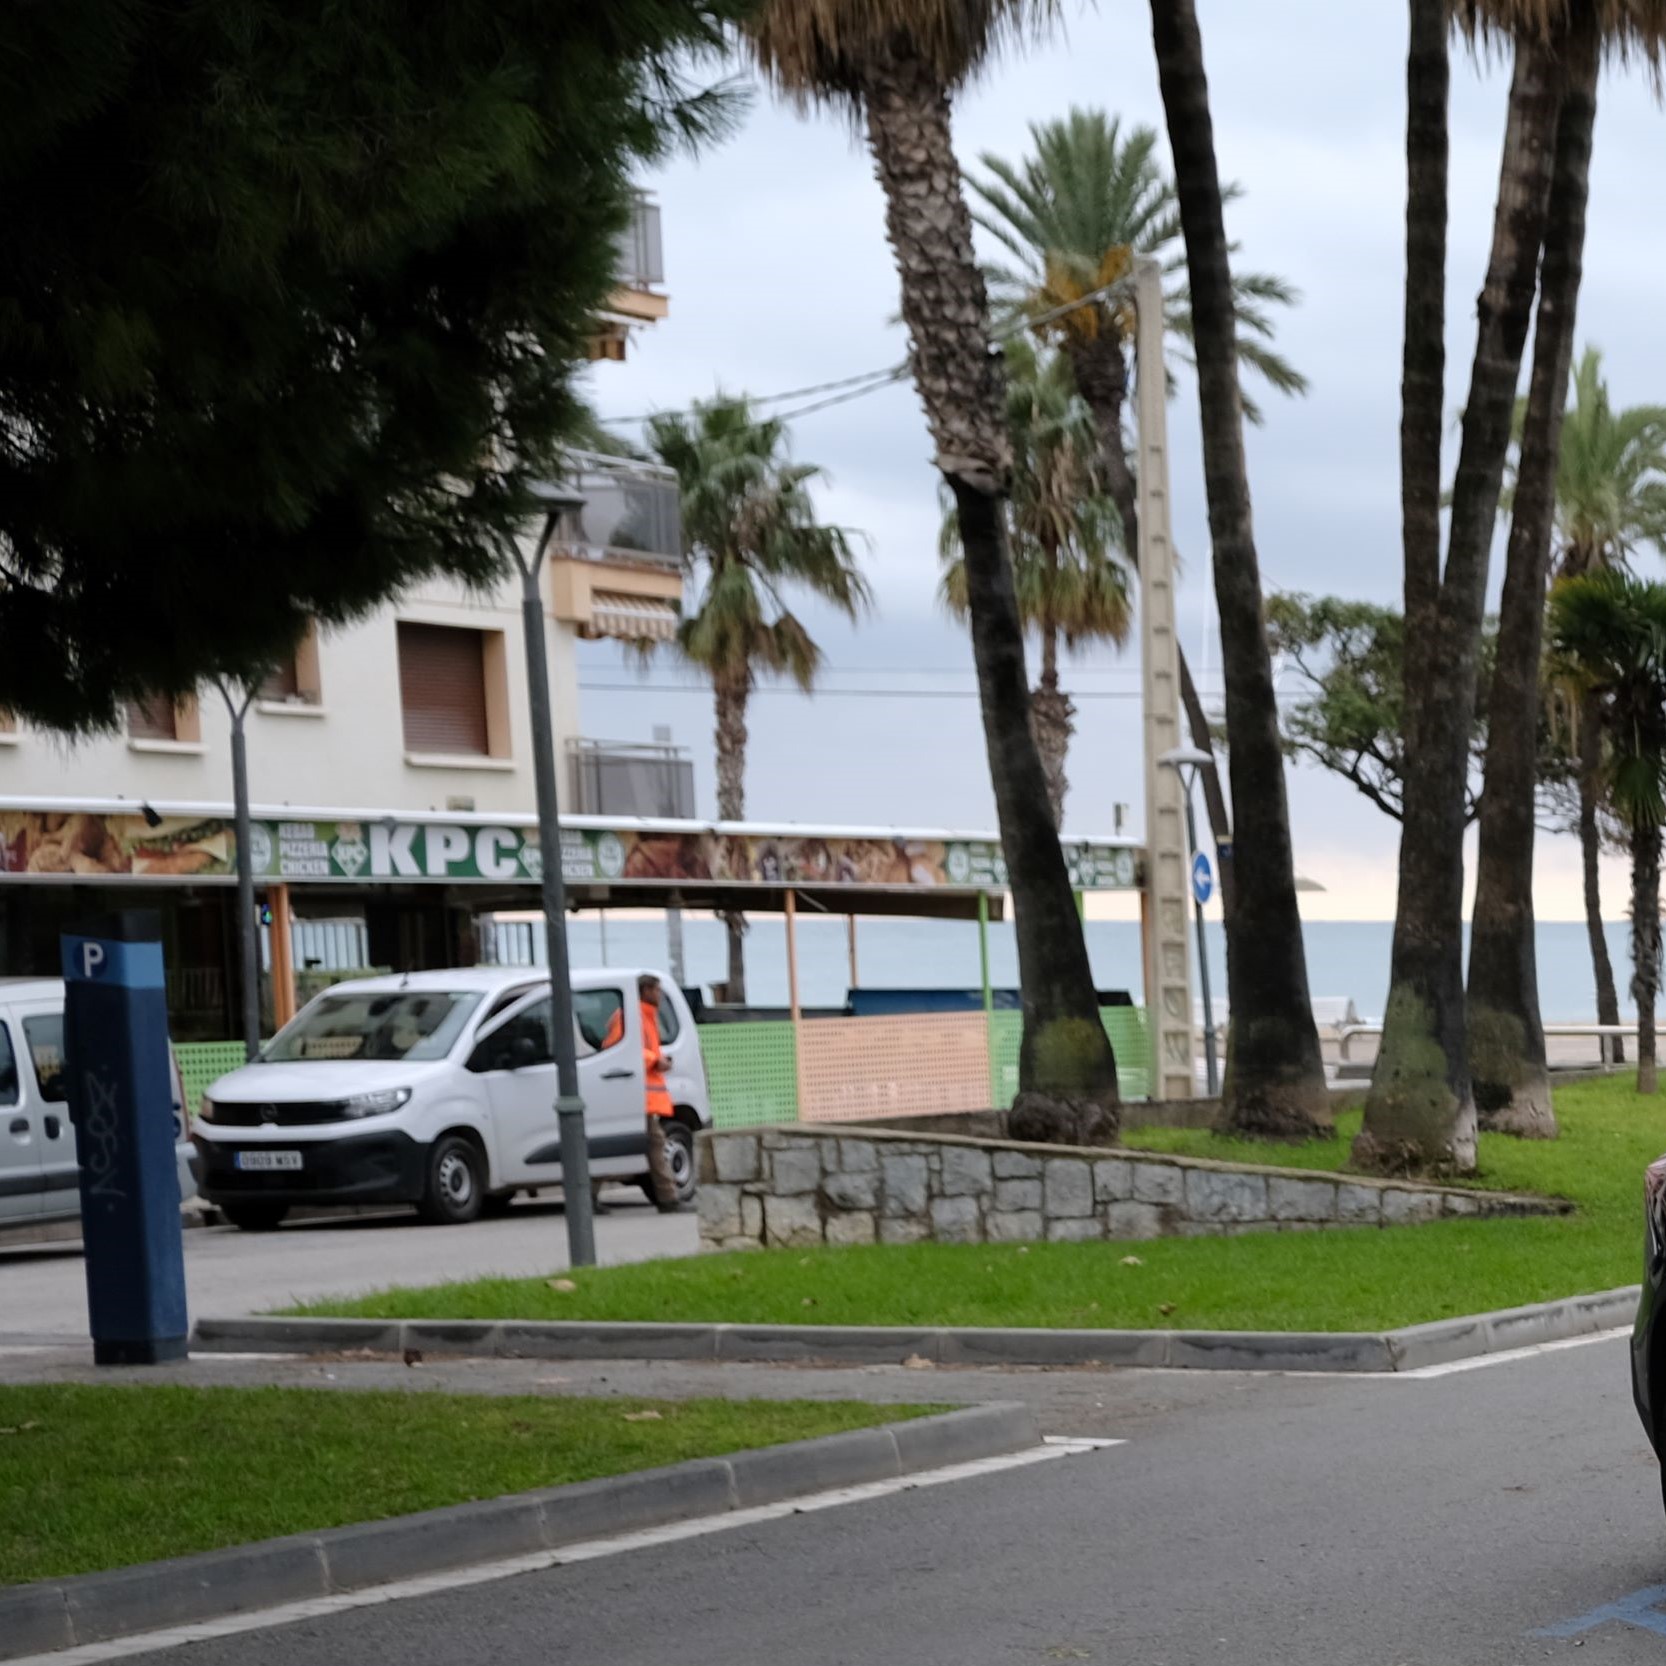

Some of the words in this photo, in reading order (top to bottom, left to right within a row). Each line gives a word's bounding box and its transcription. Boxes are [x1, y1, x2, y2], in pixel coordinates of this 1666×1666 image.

[280, 841, 328, 857] PIZZERIA
[369, 825, 519, 878] KPC
[281, 859, 329, 876] CHICKEN
[83, 942, 104, 977] P
